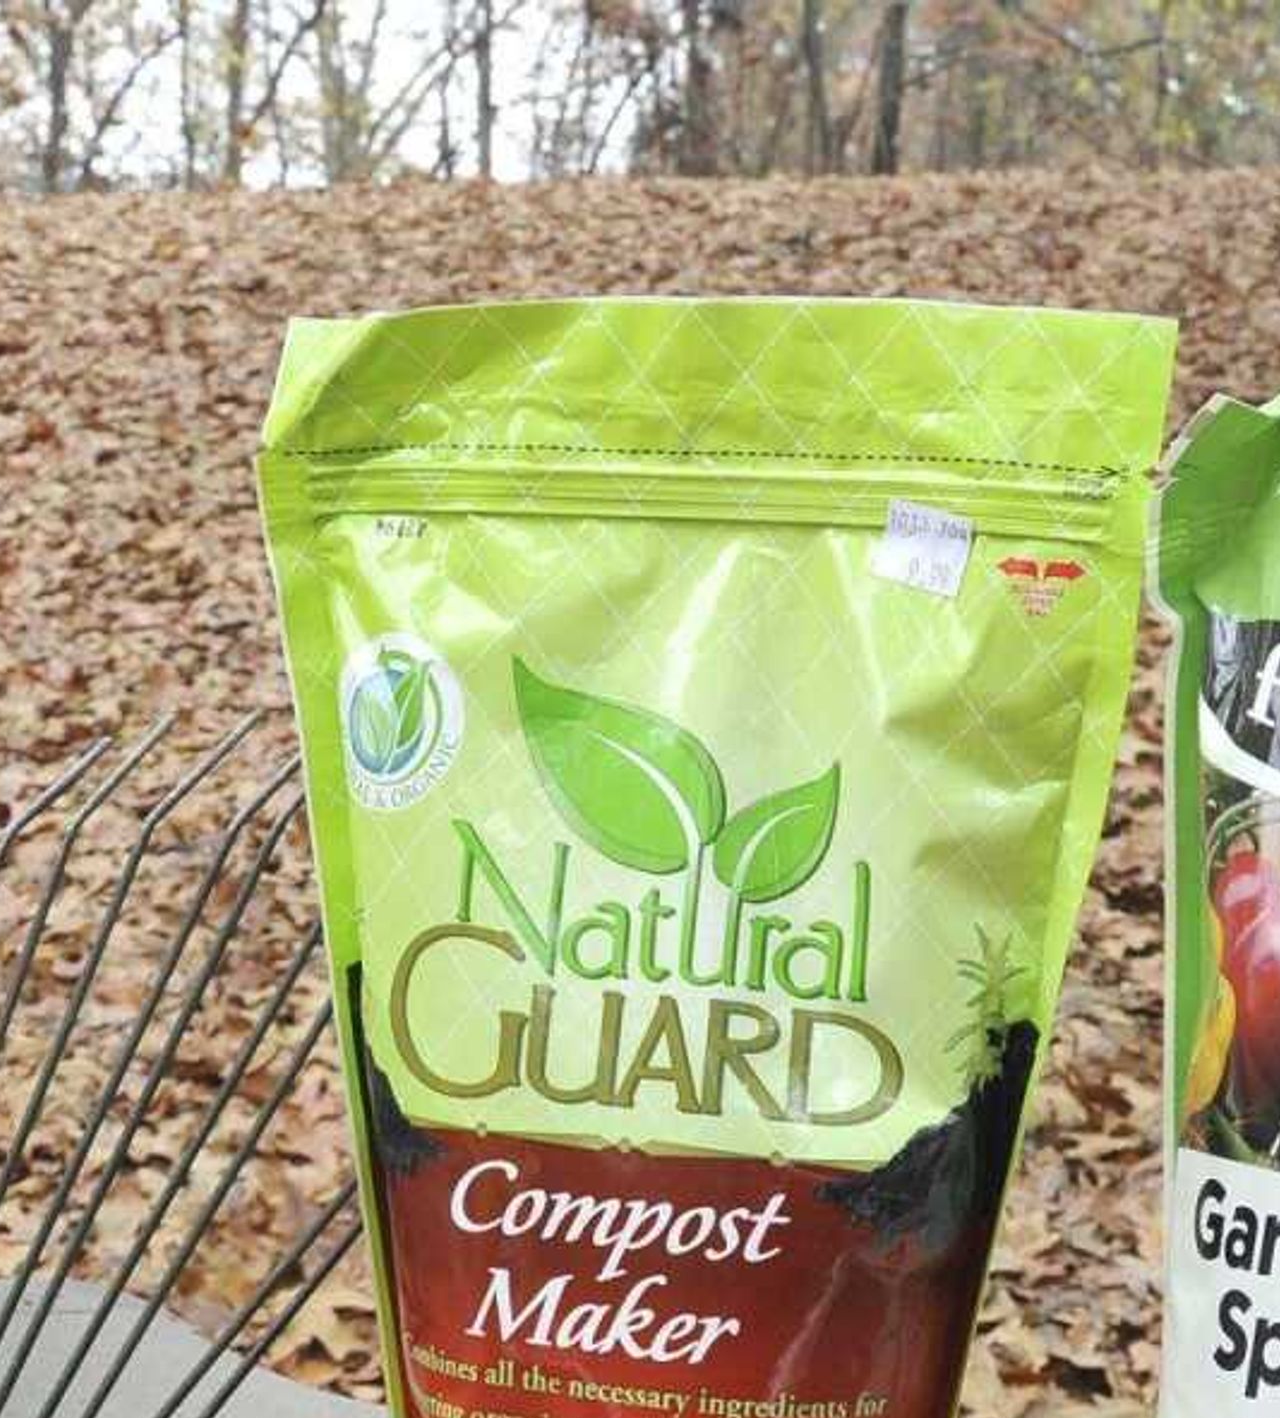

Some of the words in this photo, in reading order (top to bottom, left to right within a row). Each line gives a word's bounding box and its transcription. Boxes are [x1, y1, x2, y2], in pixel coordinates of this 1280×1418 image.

[451, 818, 870, 1001] Natural
[390, 922, 905, 1127] GUARD
[449, 1159, 792, 1281] Compost
[464, 1267, 741, 1364] Maker
[483, 1359, 514, 1387] all
[522, 1364, 561, 1393] the
[854, 1390, 888, 1418] for
